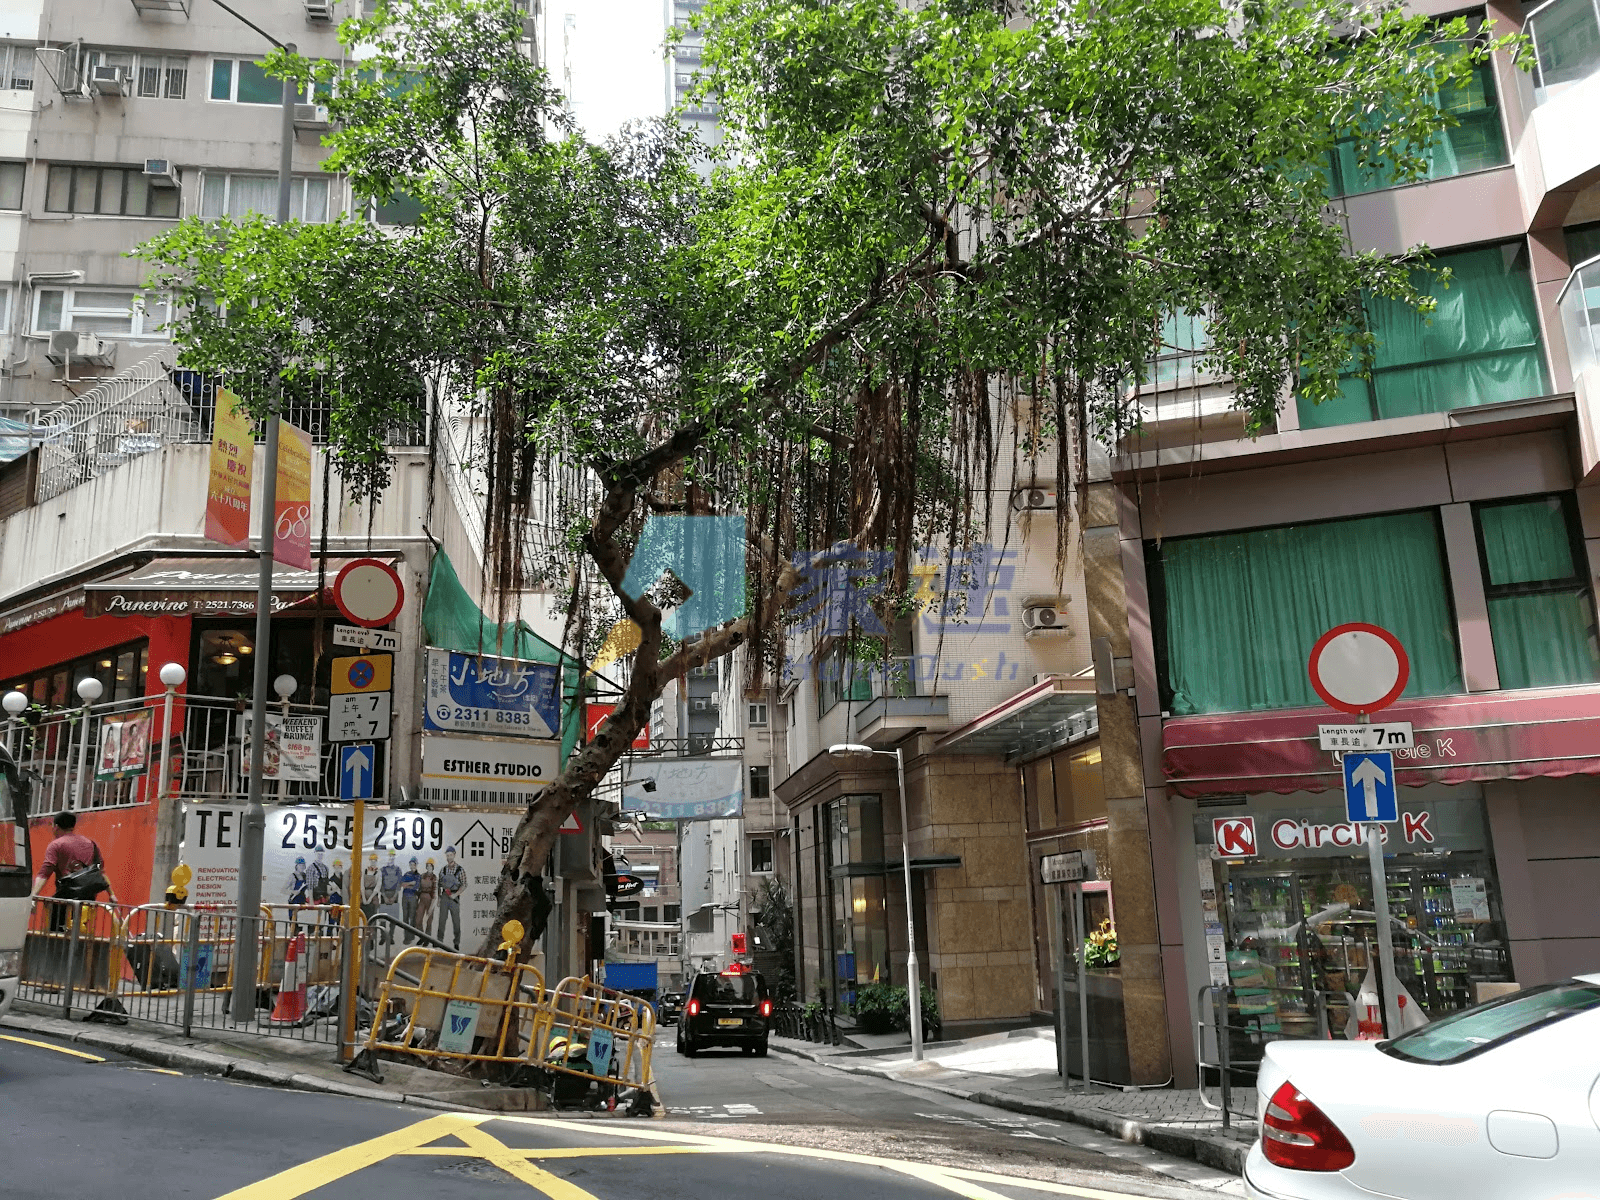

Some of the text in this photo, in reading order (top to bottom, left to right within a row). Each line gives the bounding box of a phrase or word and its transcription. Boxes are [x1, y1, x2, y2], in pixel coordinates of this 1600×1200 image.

[275, 505, 309, 540] 68
[105, 594, 189, 612] Panevino
[205, 600, 255, 610] 2521.7366
[336, 627, 357, 636] Length
[374, 633, 396, 648] 7m
[450, 657, 534, 698] 小地方
[341, 704, 359, 713] 上午
[369, 696, 379, 711] 7
[282, 717, 318, 726] WEEKEND
[454, 707, 530, 725] 2311 8383
[285, 725, 314, 733] BUFFET
[341, 729, 358, 738] 下午
[368, 721, 378, 736] 7
[1322, 727, 1349, 736] Length
[1373, 728, 1406, 745] 7m
[283, 732, 314, 741] BRUNCH
[1330, 736, 1361, 747] 車長逾
[1436, 737, 1457, 758] K
[443, 759, 542, 777] ESTHER STUDIO
[282, 812, 354, 850] 2555
[374, 816, 443, 851] 2599
[502, 827, 514, 837] THE
[1402, 811, 1434, 843] K
[1223, 823, 1248, 854] K
[473, 892, 498, 902] 室內設
[473, 909, 498, 919] 訂製傢
[472, 926, 490, 937] 小型
